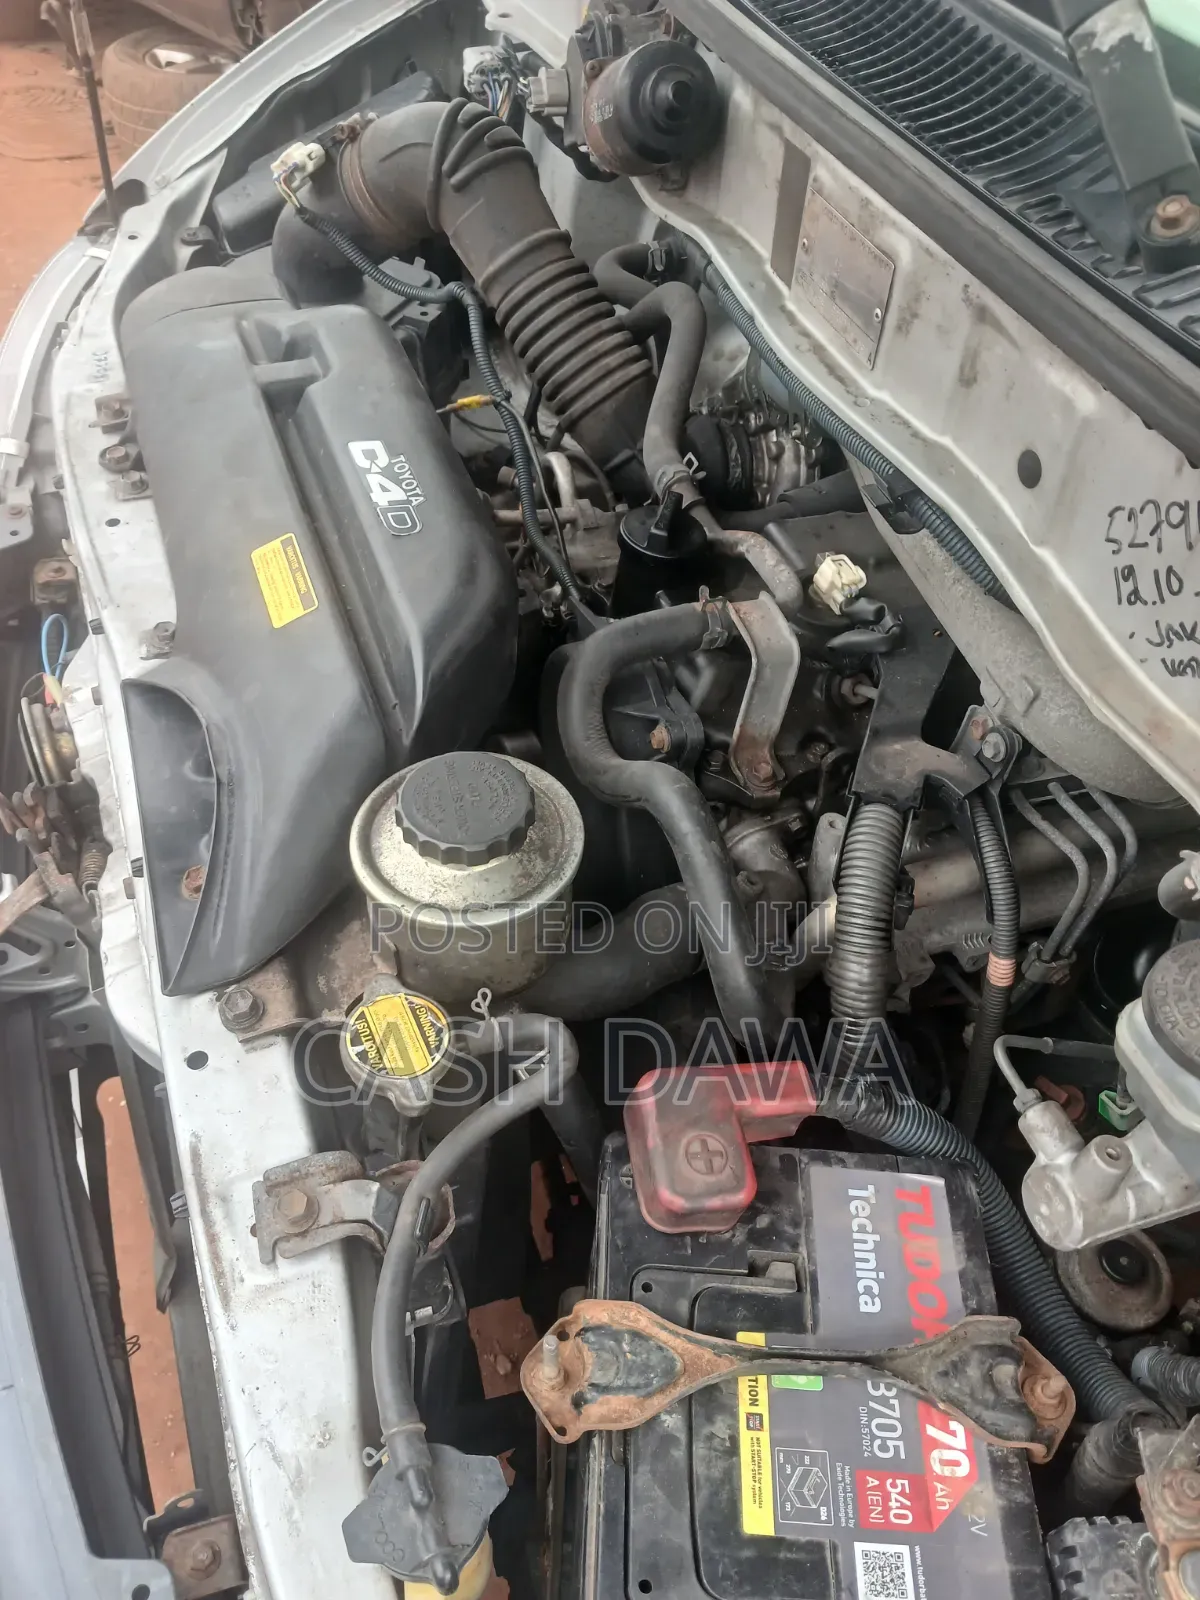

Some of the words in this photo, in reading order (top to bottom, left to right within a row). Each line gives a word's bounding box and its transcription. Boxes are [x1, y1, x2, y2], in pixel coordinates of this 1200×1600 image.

[390, 454, 424, 507] TOYOTA
[355, 1019, 384, 1070] VAROITUS!
[415, 1003, 440, 1048] VARNING!
[848, 1184, 885, 1314] Technica
[748, 1376, 759, 1407] TION
[859, 1406, 872, 1457] DIN:57024
[926, 1420, 970, 1478] 70
[838, 1482, 846, 1527] Technologies
[886, 1478, 913, 1525] 540
[933, 1481, 954, 1510] Ah
[848, 1519, 855, 1528] by
